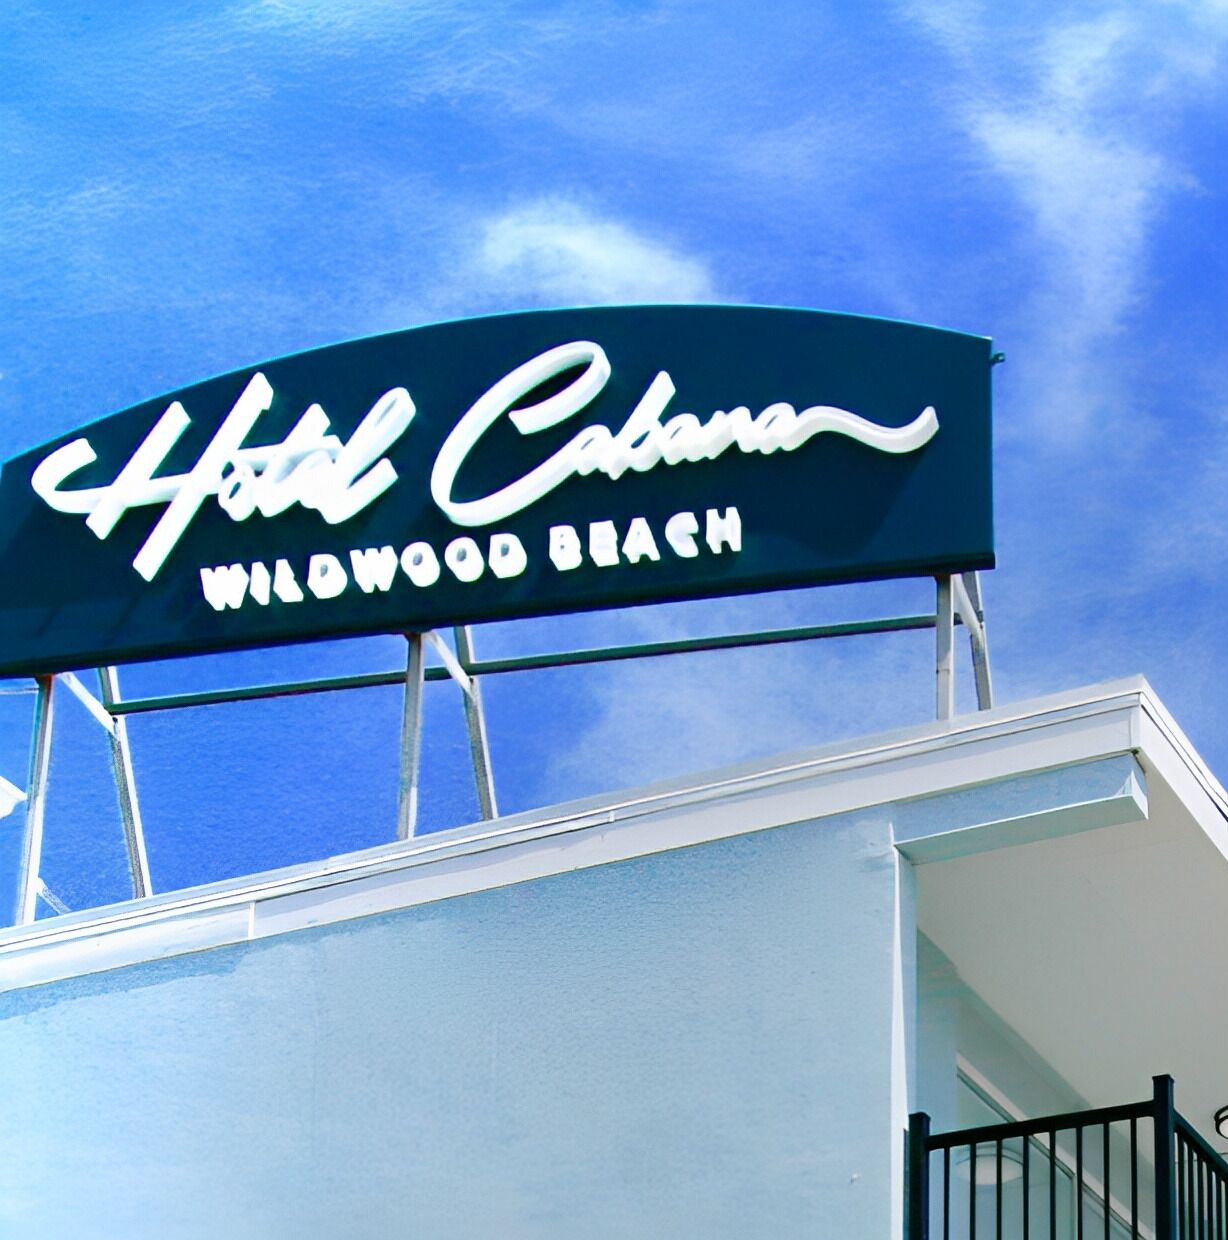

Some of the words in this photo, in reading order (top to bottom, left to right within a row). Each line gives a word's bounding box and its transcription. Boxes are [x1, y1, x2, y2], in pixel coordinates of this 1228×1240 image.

[31, 371, 417, 581] Hotel
[431, 340, 940, 527] Cabana
[200, 533, 528, 611] WILDWOOD
[549, 506, 743, 571] BEACH
